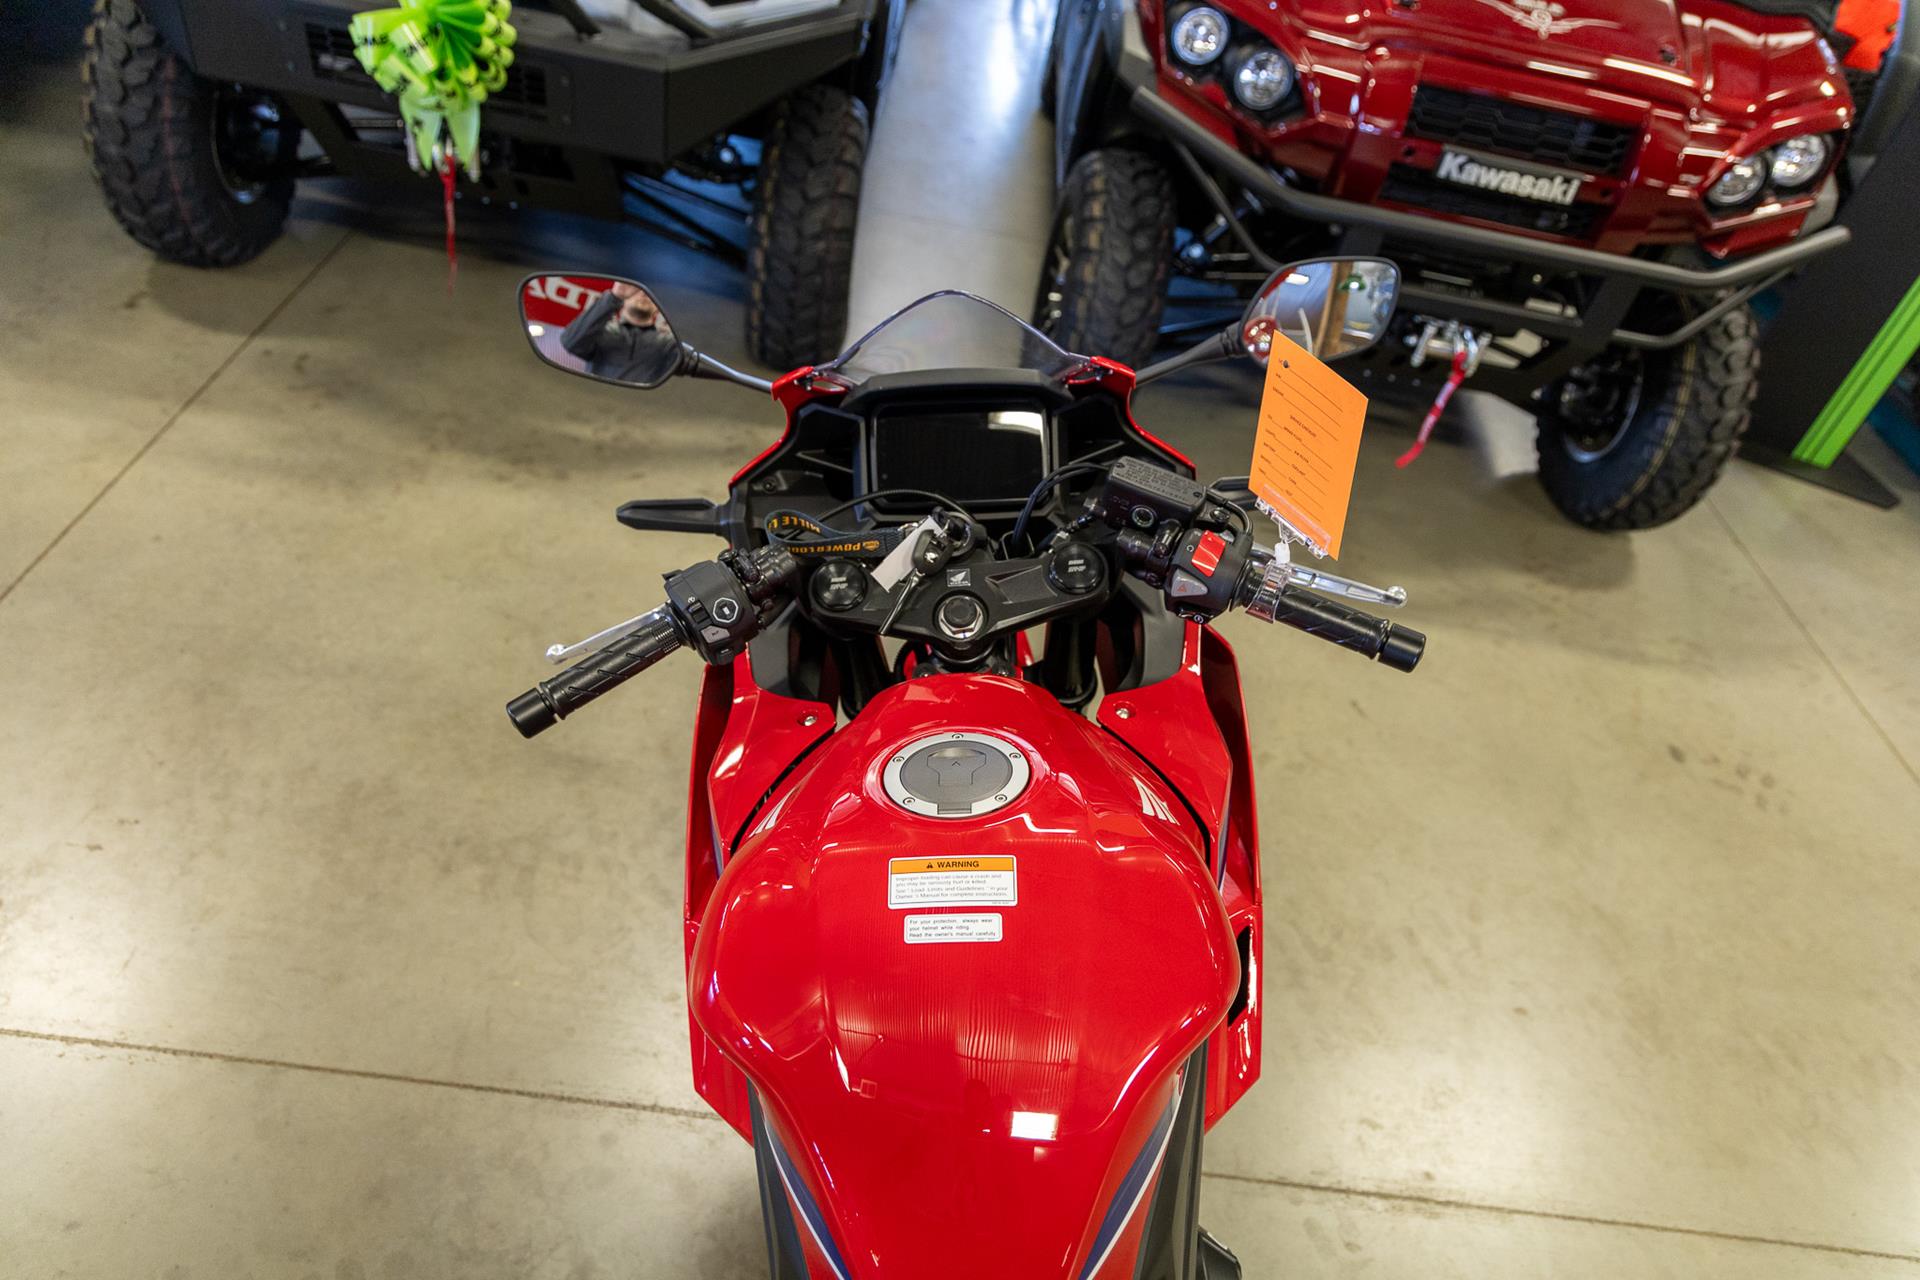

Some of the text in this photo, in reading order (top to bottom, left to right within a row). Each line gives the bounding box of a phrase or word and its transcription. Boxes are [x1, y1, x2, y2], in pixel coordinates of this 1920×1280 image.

[1436, 151, 1581, 206] Kawasaki
[781, 516, 822, 534] MILLE
[937, 860, 979, 868] WARNING
